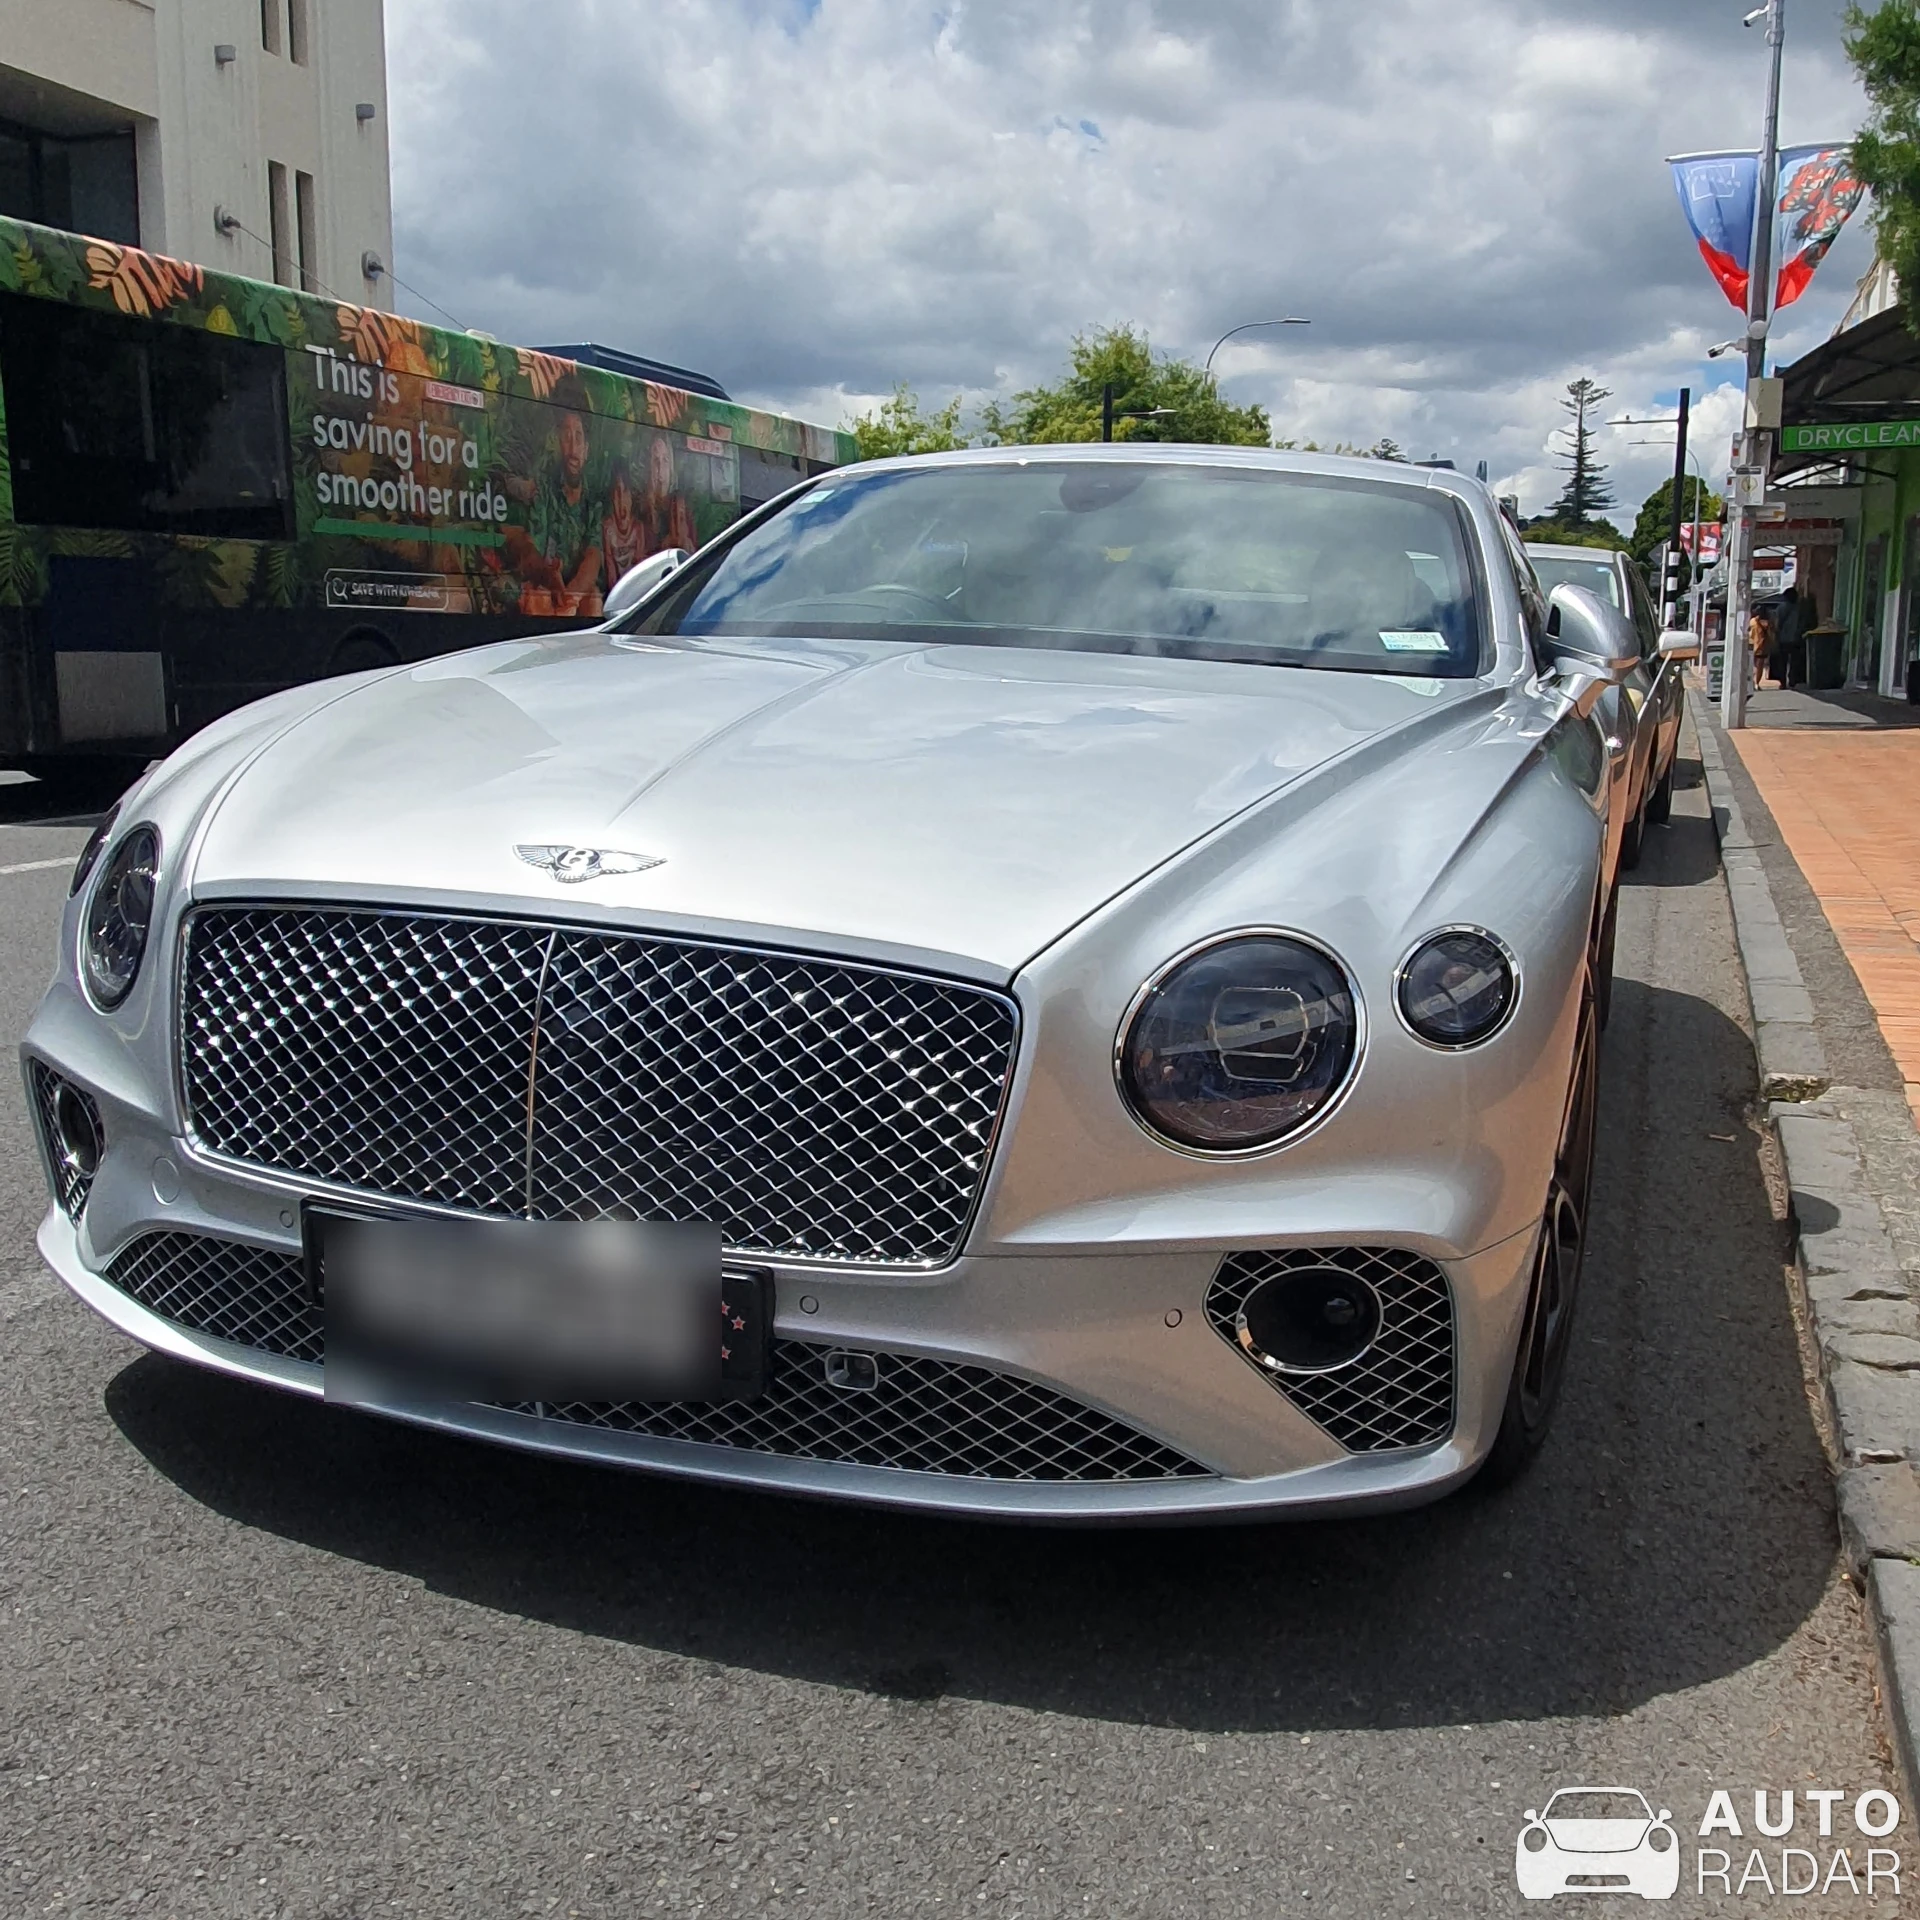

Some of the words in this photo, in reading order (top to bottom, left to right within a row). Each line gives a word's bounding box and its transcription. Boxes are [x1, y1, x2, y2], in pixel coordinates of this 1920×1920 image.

[305, 343, 373, 399] This
[376, 358, 400, 404] is
[313, 411, 413, 470] saving
[418, 420, 456, 465] for
[461, 439, 479, 469] a
[316, 471, 453, 516] smoother
[458, 480, 508, 522] ride
[351, 582, 374, 596] SAVE
[376, 583, 398, 597] WITH
